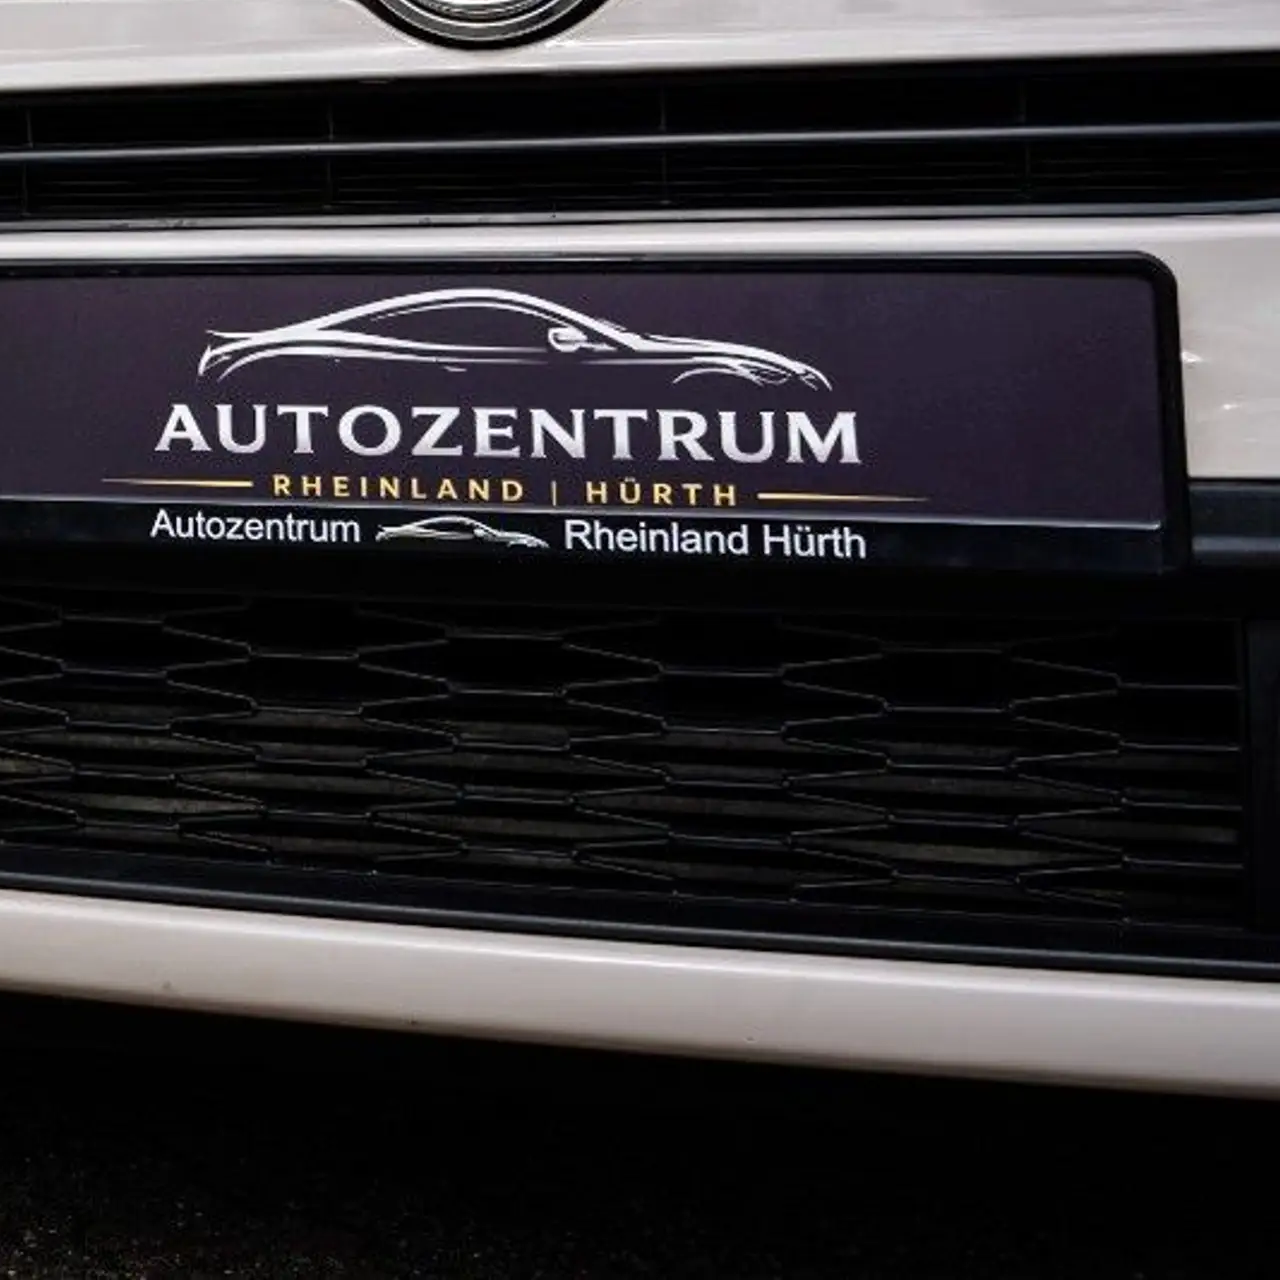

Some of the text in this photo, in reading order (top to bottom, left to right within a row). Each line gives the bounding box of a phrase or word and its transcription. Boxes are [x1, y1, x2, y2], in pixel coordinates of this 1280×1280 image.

[154, 403, 861, 464] AUTOZENTRUM
[272, 473, 737, 507] RHEINLAND HÜRTH
[150, 508, 867, 560] Autozentrum Rheinland Hürth
